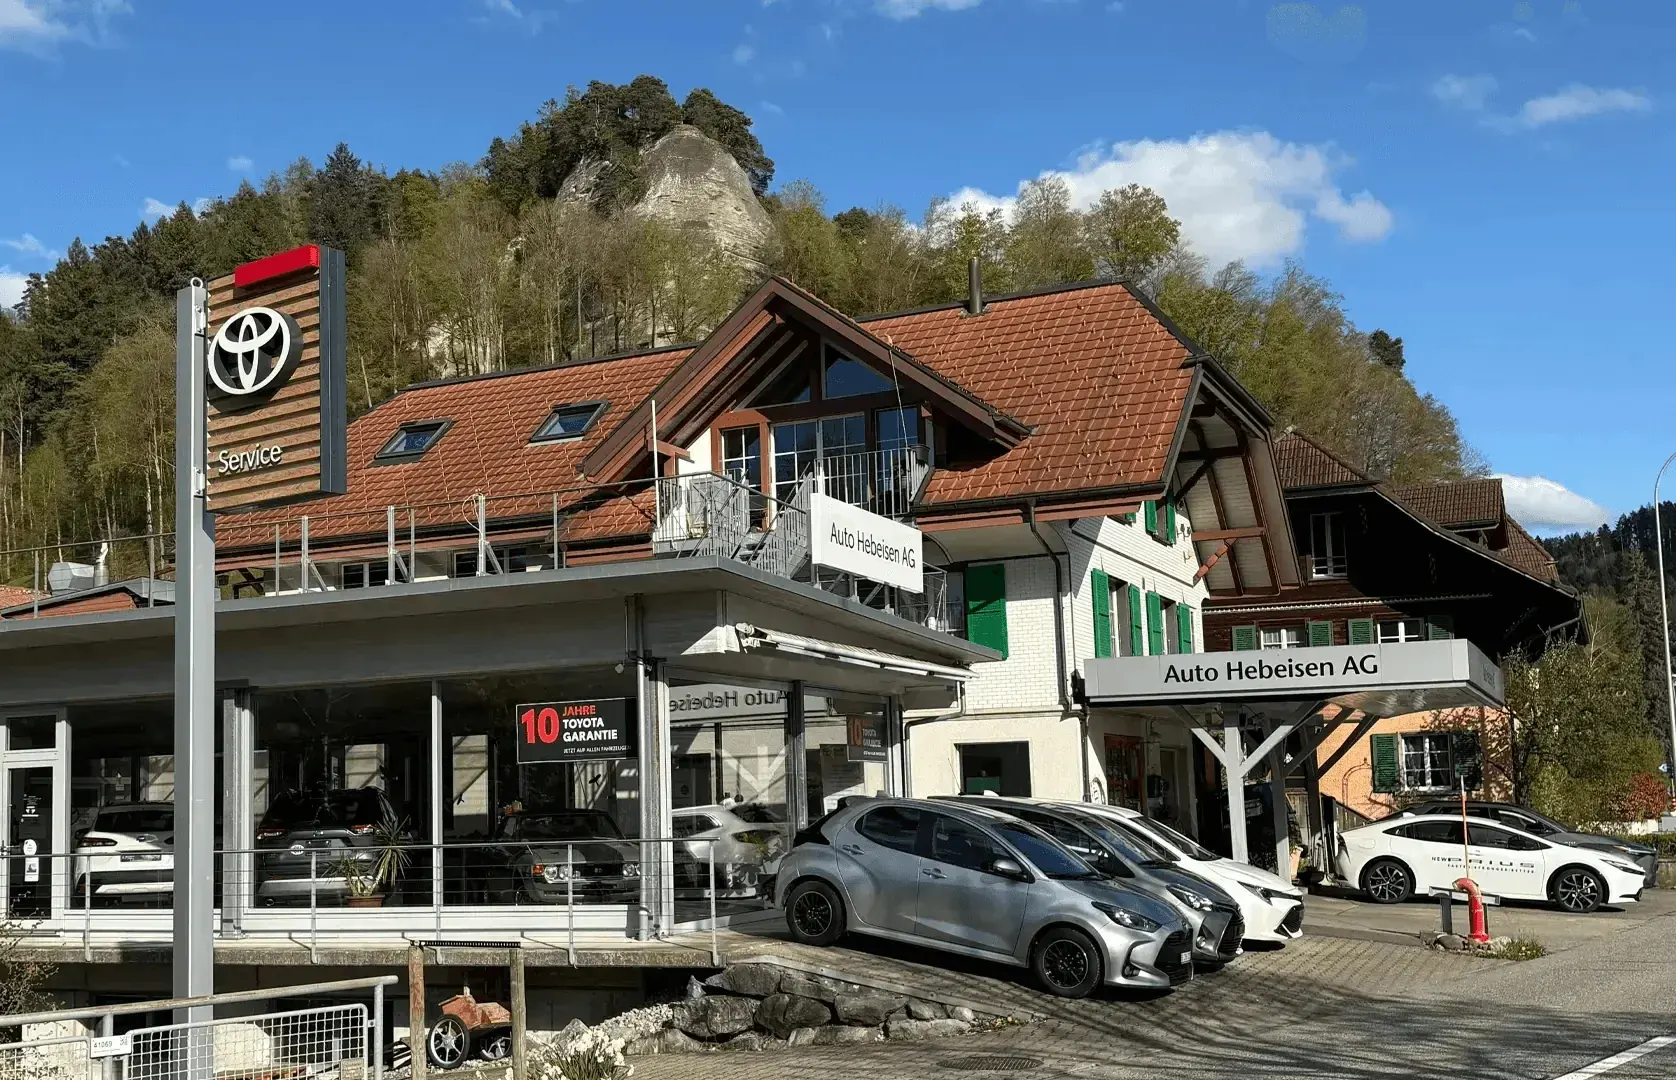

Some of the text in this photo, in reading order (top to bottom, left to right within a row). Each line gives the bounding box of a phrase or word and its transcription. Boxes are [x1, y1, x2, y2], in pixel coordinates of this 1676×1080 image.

[218, 443, 282, 473] Service
[830, 521, 916, 569] Auto Hebeisen AG
[1164, 654, 1378, 683] Auto Hebeisen AG
[521, 707, 560, 744] 10
[562, 705, 596, 717] JAHRE
[563, 717, 605, 729] TOYOTA
[563, 729, 618, 742] GARANTIE
